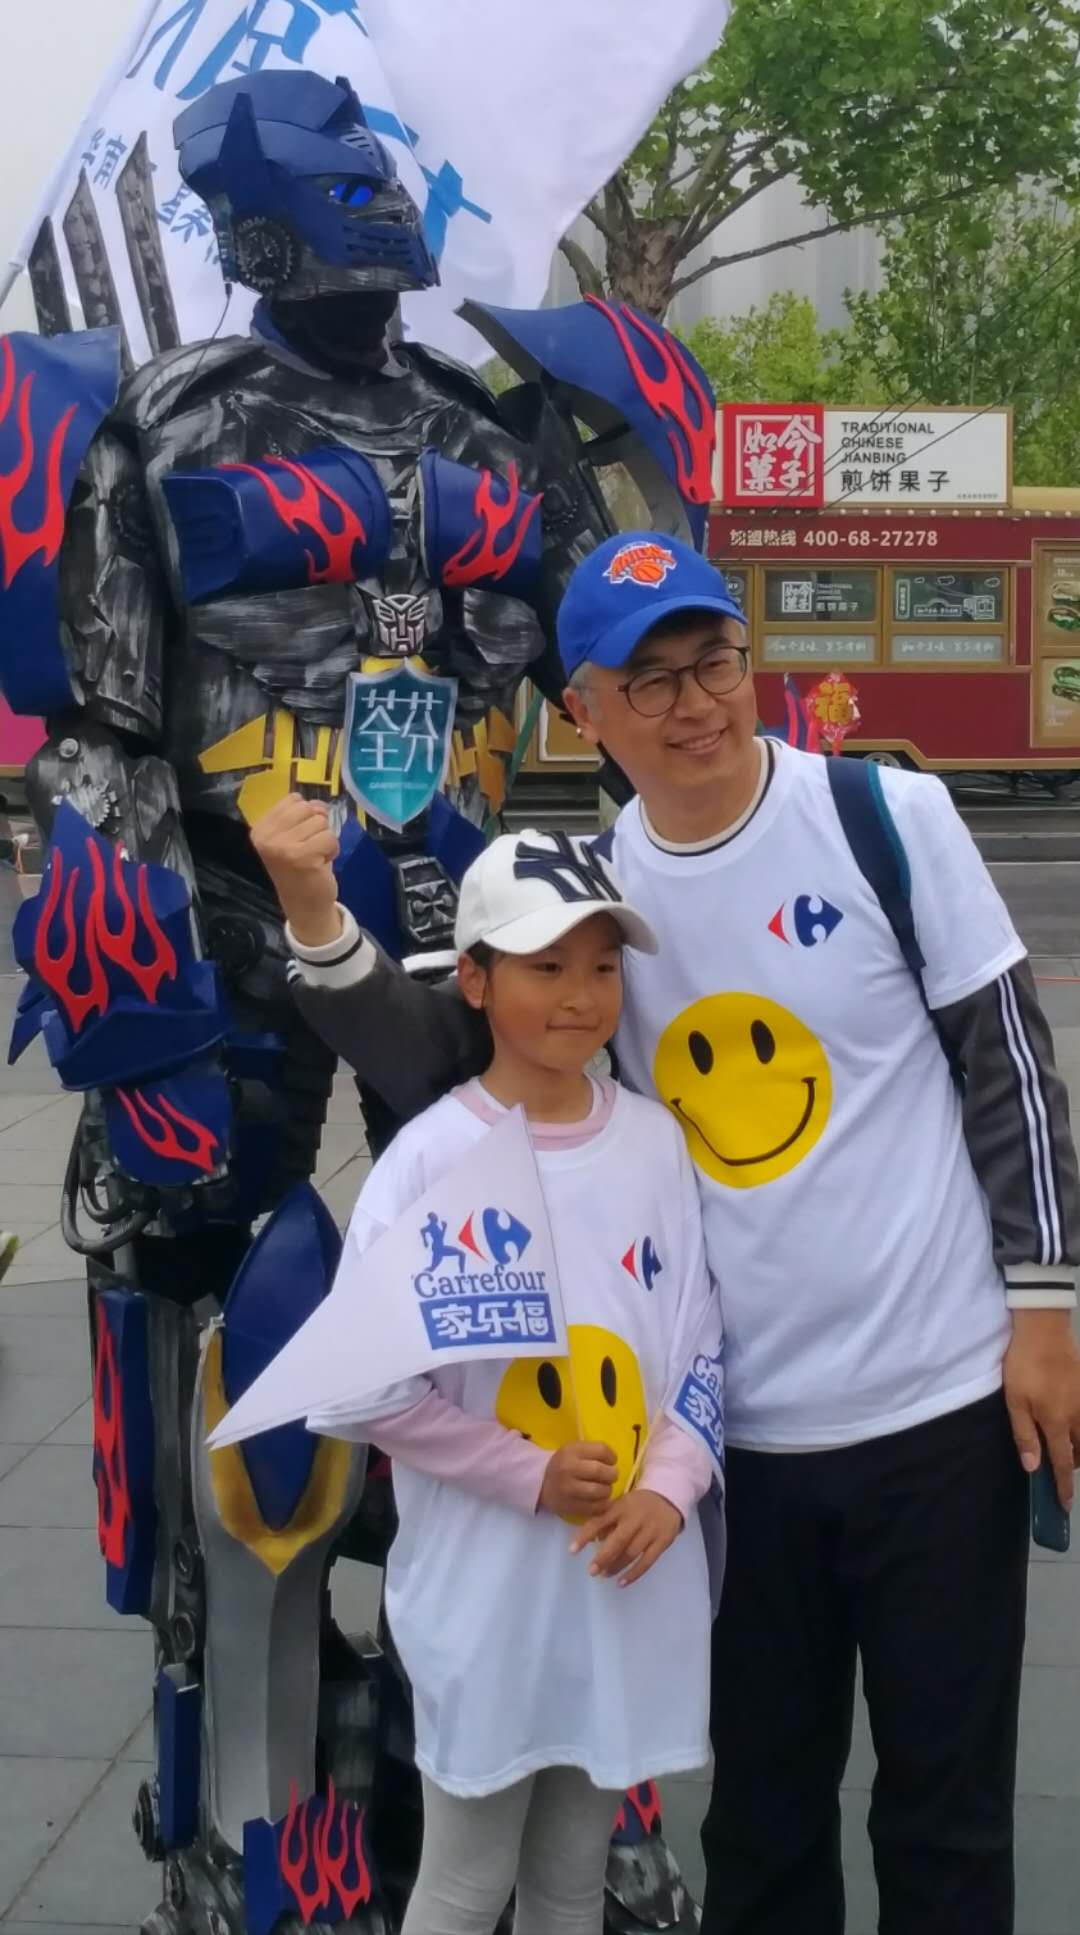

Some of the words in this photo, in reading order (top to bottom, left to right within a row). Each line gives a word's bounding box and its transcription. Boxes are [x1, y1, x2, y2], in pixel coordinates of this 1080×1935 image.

[841, 421, 935, 434] TRADITIONAL
[841, 436, 904, 449] CHINESE
[841, 452, 907, 464] JIANBING
[840, 468, 950, 493] 煎饼果子
[803, 529, 938, 547] 400-68-27278
[413, 1264, 546, 1299] Carrefour
[430, 1299, 550, 1340] 家乐福
